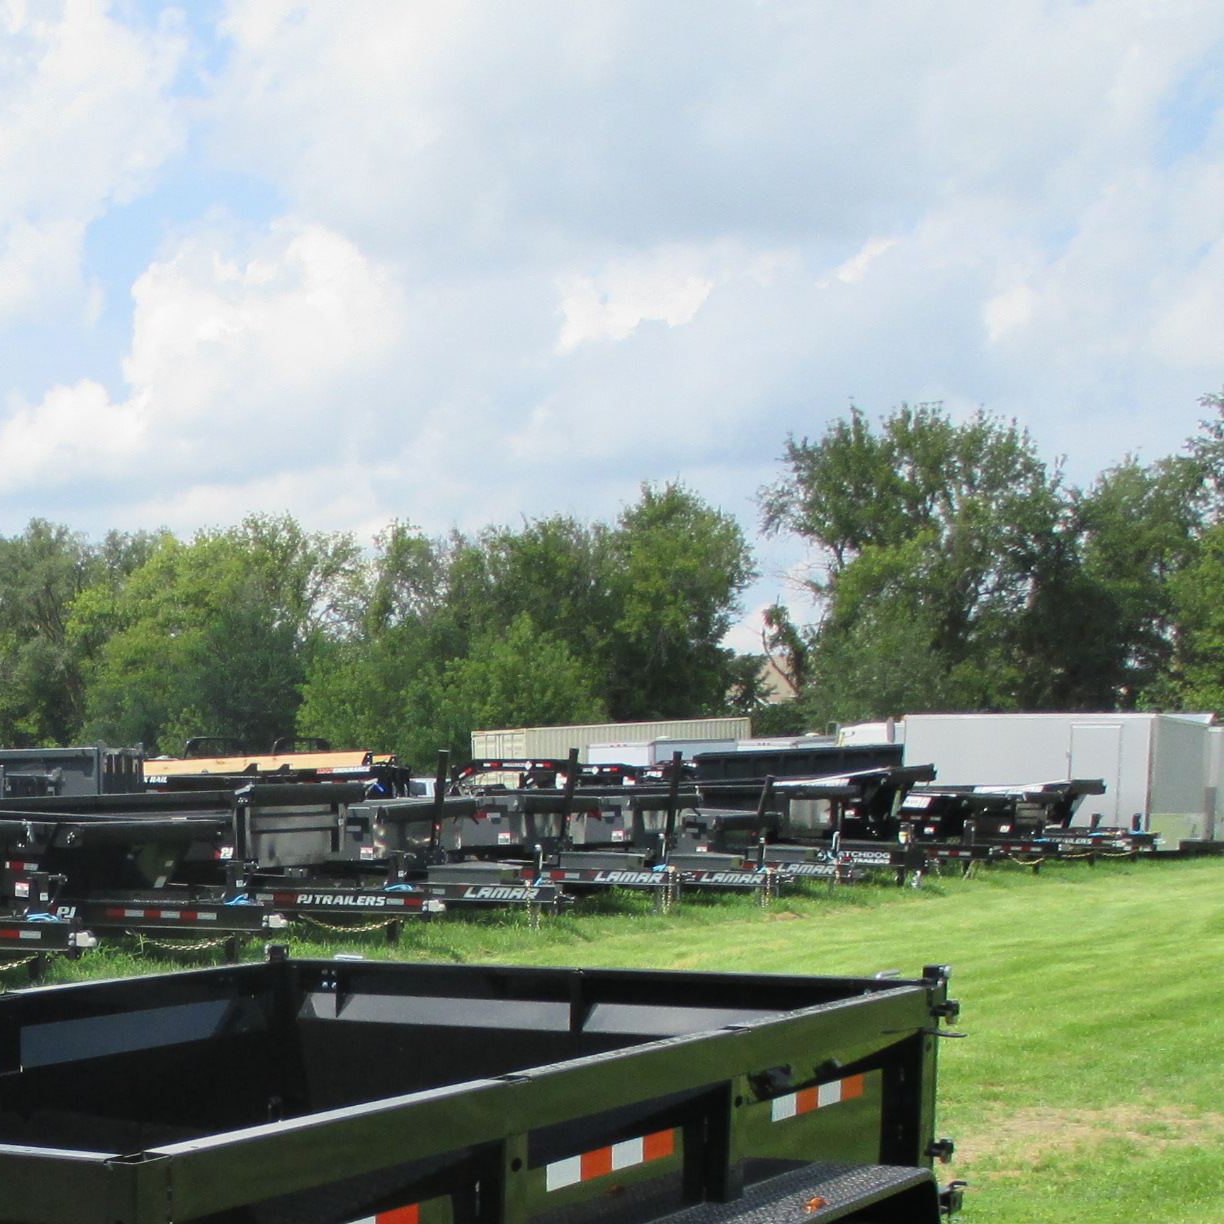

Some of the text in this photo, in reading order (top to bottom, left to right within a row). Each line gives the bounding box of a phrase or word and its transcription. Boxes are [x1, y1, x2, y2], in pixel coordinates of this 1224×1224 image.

[776, 863, 836, 875] LAMAR
[593, 871, 665, 884] LAMAR
[699, 871, 765, 884] LAMAR
[463, 886, 540, 900] LAMAR
[314, 894, 387, 907] TRAILERS
